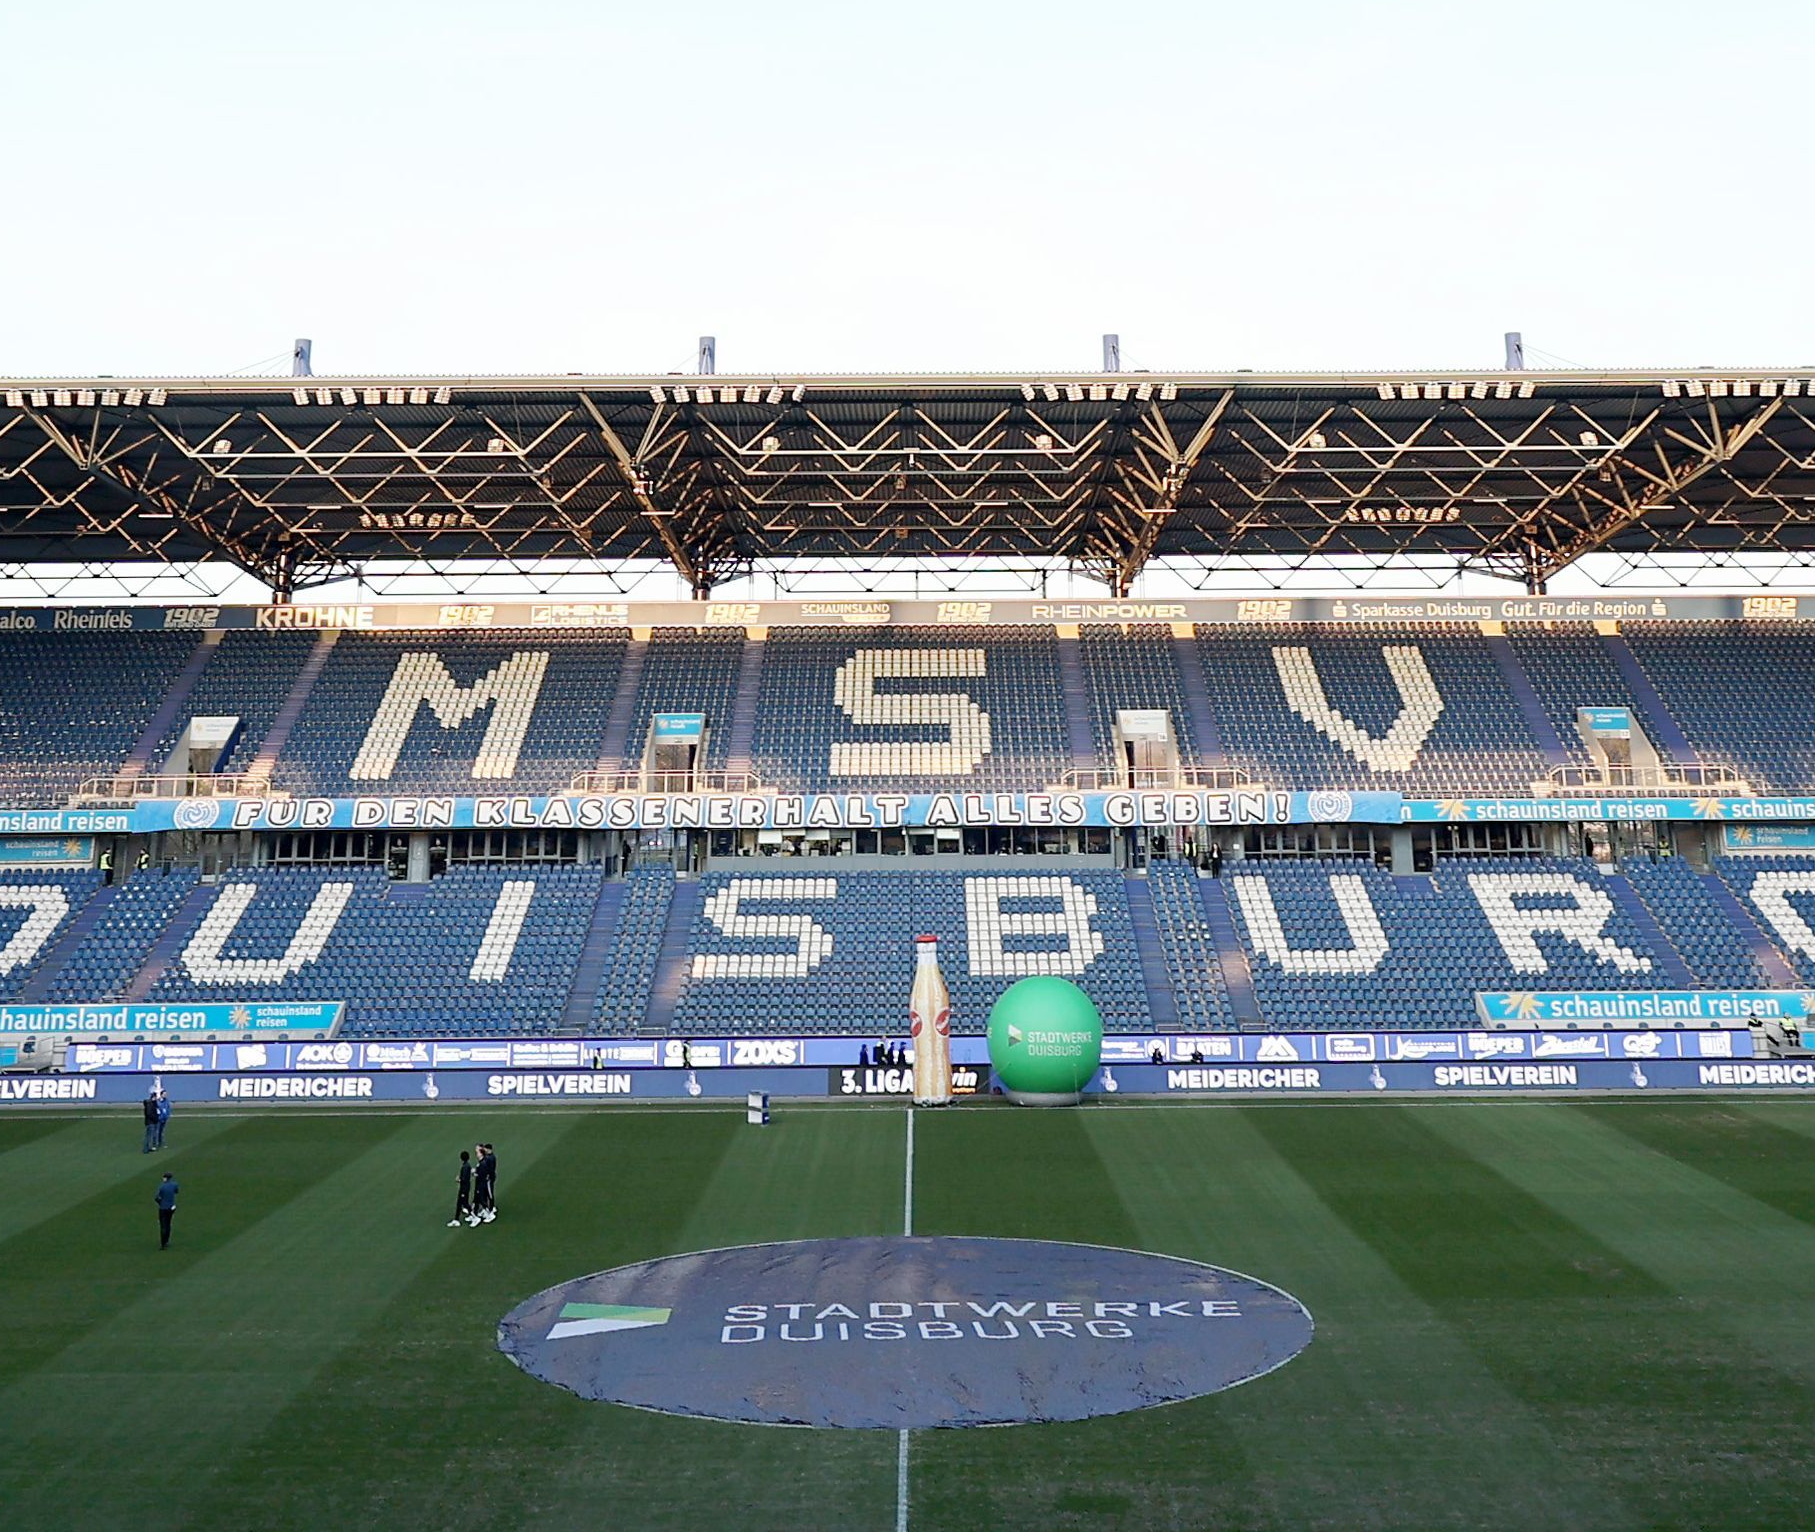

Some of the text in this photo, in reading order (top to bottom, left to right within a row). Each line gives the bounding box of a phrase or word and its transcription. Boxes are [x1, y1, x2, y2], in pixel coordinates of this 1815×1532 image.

[53, 609, 133, 630] Rheinfels
[255, 606, 373, 628] KROHNE
[551, 604, 628, 616] RHENUS
[801, 603, 890, 614] SCHAUINSLAND
[1031, 602, 1188, 619] RHEINPOWER
[1351, 599, 1646, 622] Sparkasse Duisburg Gut. Für die Region
[551, 616, 629, 626] LOGISTICS
[232, 791, 1291, 829] FÜR DEN KLASSENERHALT ALLES GEBEN!
[1476, 799, 1667, 820] schauinsland reisen
[69, 811, 128, 831] reisen
[1550, 995, 1779, 1018] schauinsland reisen
[135, 1008, 206, 1029] reisen
[1027, 1030, 1094, 1044] STADTWERKE
[297, 1045, 333, 1061] AOK
[734, 1041, 798, 1064] ZOXS
[1028, 1044, 1082, 1057] DUISBURG
[488, 1074, 631, 1097] SPIELVEREIN
[841, 1068, 914, 1093] 3. LIGA
[1168, 1067, 1321, 1090] MEIDERICHER
[1434, 1065, 1577, 1087] SPIELVEREIN
[219, 1077, 373, 1099] MEIDERICHER
[724, 1301, 1242, 1323] STADTWERKE
[720, 1320, 1134, 1343] DUISBURG
